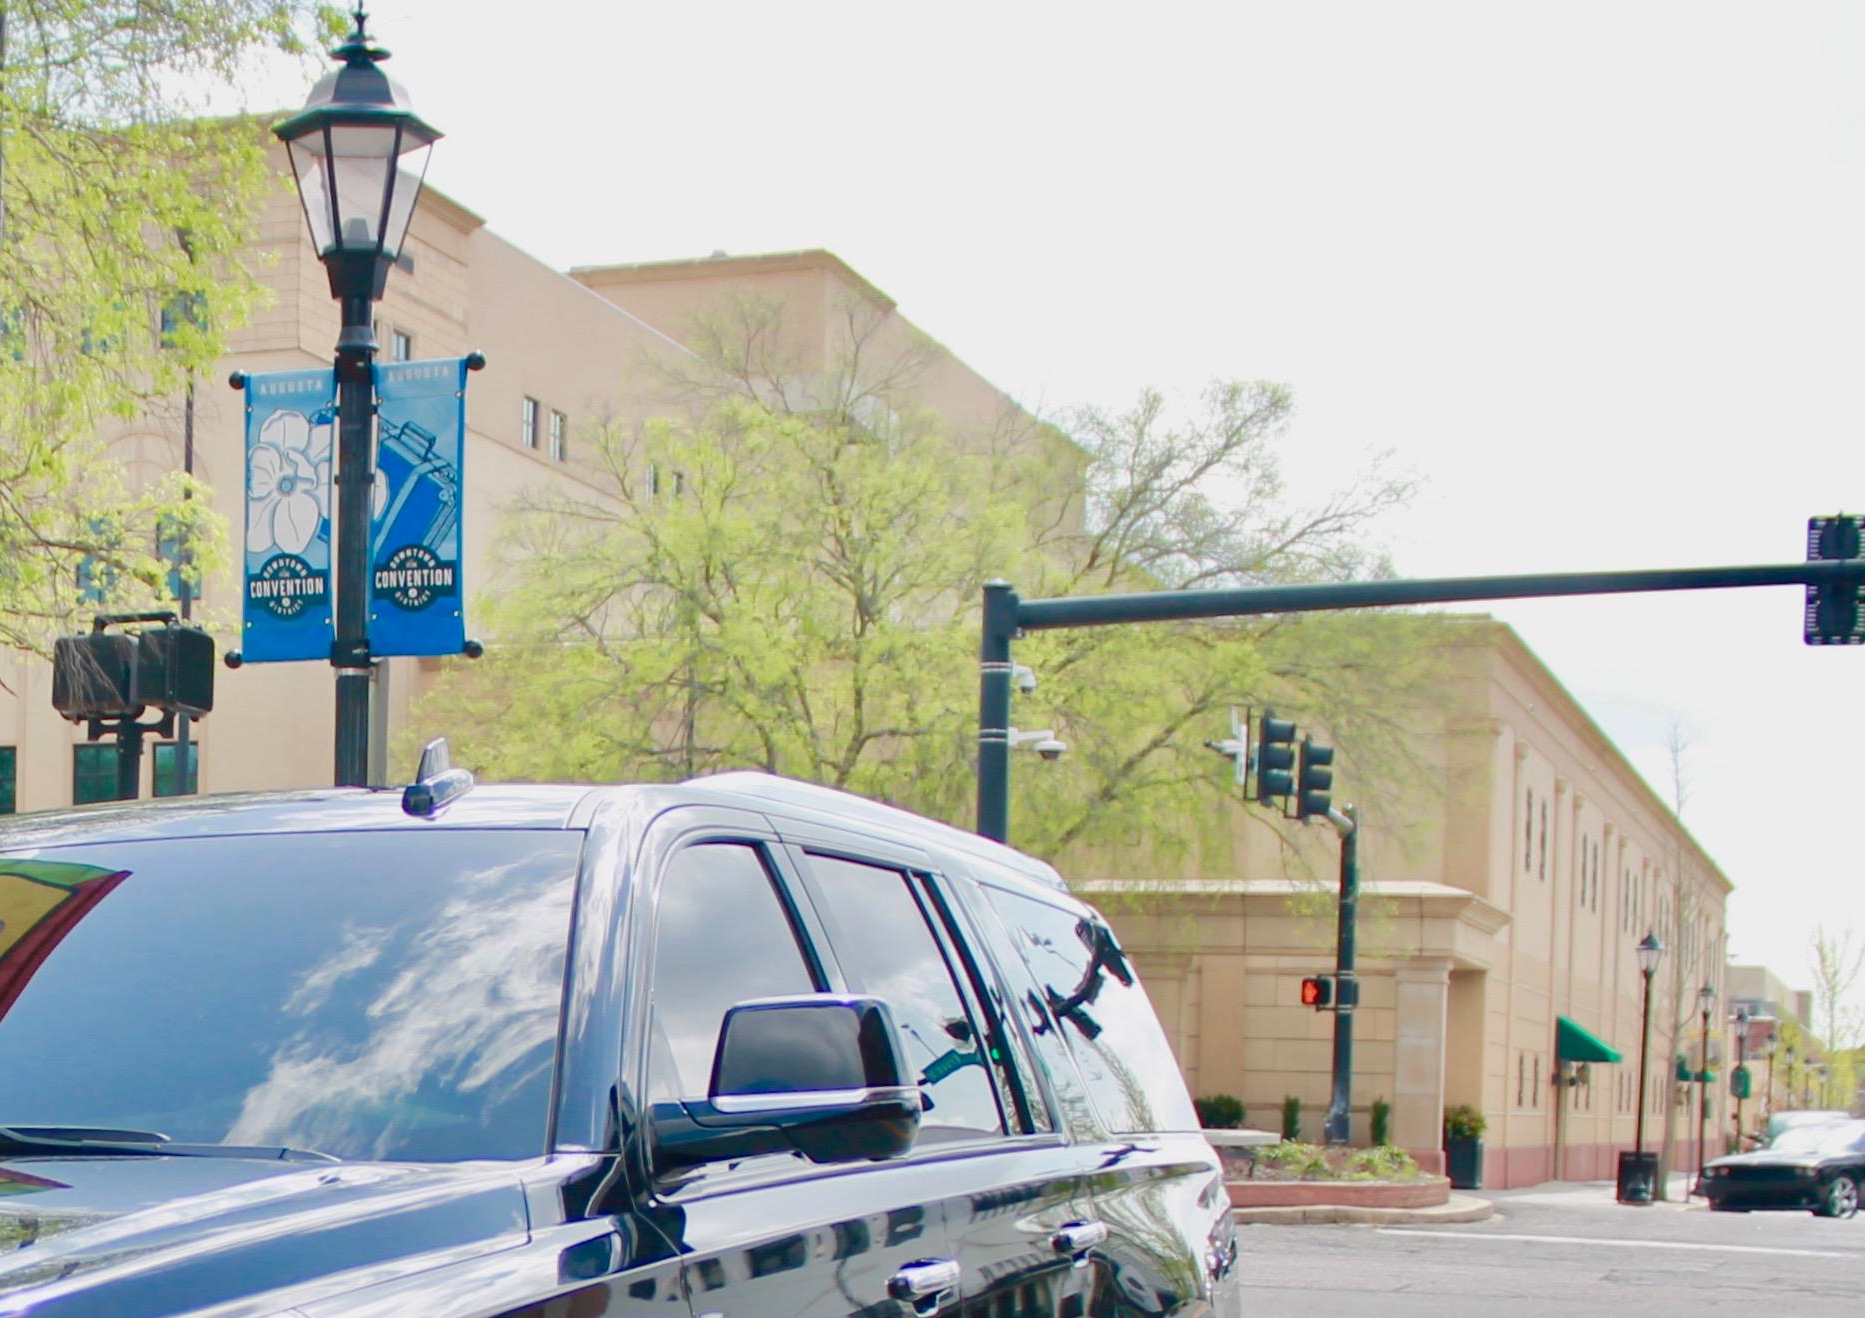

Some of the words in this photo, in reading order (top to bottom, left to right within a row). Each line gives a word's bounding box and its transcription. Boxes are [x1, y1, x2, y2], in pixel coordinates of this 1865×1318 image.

[388, 365, 450, 382] AUGUSTA
[260, 379, 323, 395] AUGUSTA
[389, 548, 435, 569] DOWNTOWN
[263, 558, 308, 578] DOWNTOWN
[250, 577, 324, 598] CONVENTION
[375, 568, 453, 589] CONVENTION
[269, 599, 303, 615] DISTRICT
[395, 590, 431, 607] DISTRICT
